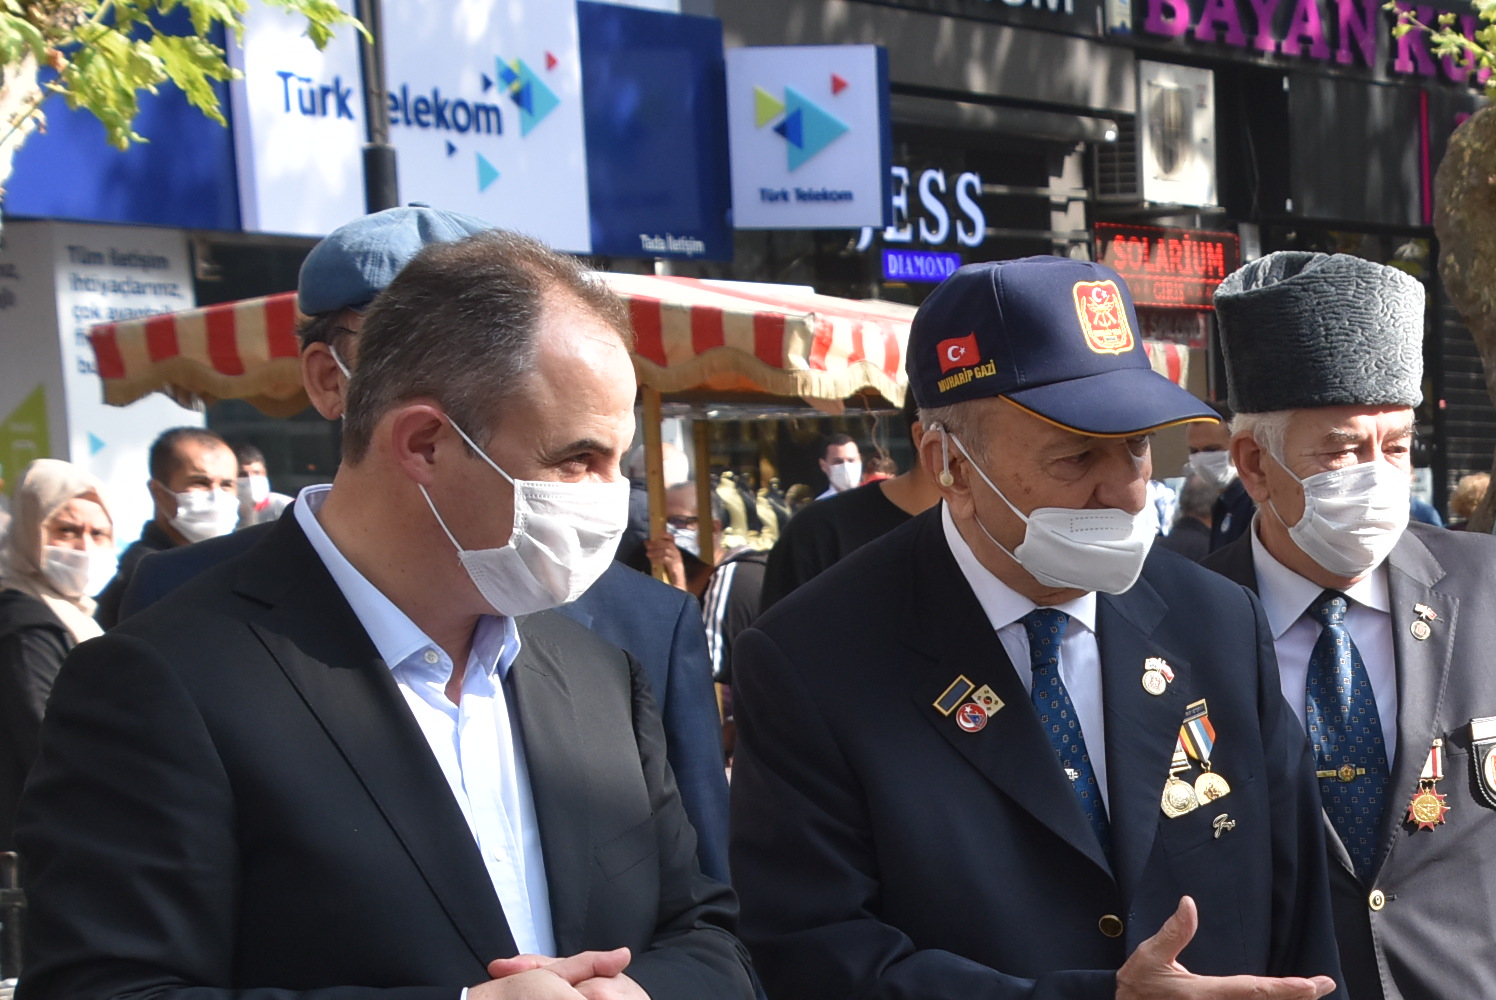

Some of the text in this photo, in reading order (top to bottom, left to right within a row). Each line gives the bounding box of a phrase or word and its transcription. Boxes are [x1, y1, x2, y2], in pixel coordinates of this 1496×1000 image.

[276, 70, 503, 135] Türk elekom
[759, 186, 854, 202] Türk Telekom
[887, 254, 956, 277] DIAMOND
[937, 358, 997, 393] MUHARİP GAZİ
